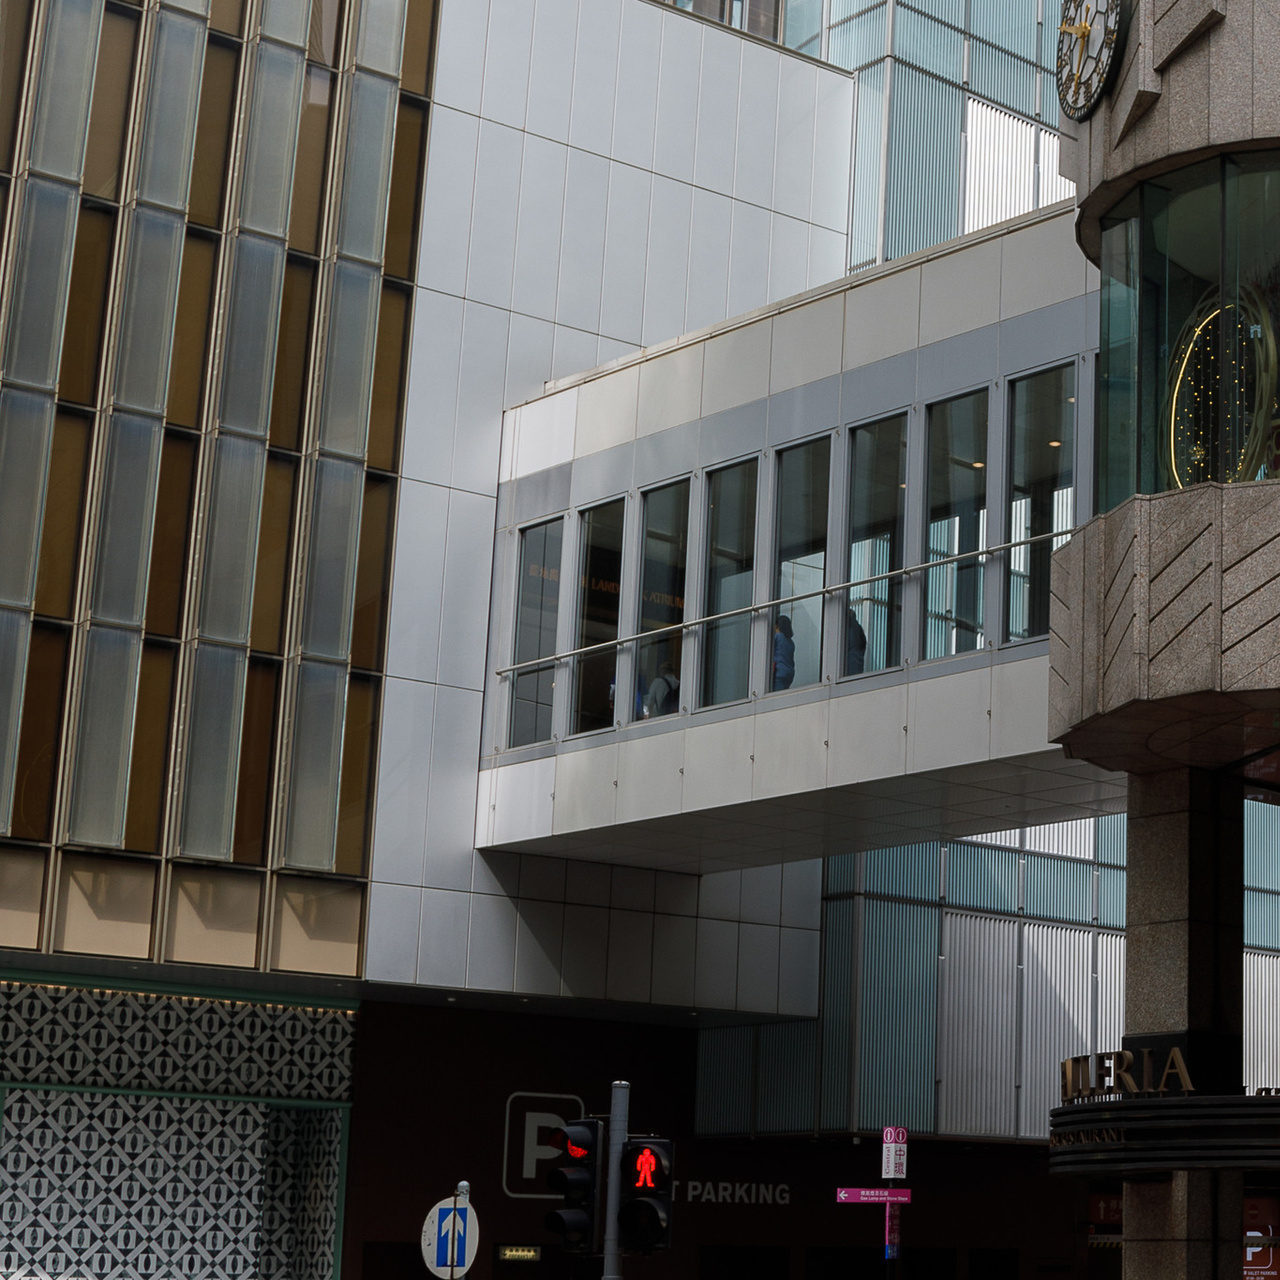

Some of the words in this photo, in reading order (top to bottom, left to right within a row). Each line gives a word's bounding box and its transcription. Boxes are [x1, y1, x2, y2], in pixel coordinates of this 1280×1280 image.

[522, 1111, 568, 1179] P
[894, 1146, 906, 1175] 中環
[687, 1180, 791, 1205] PARKING
